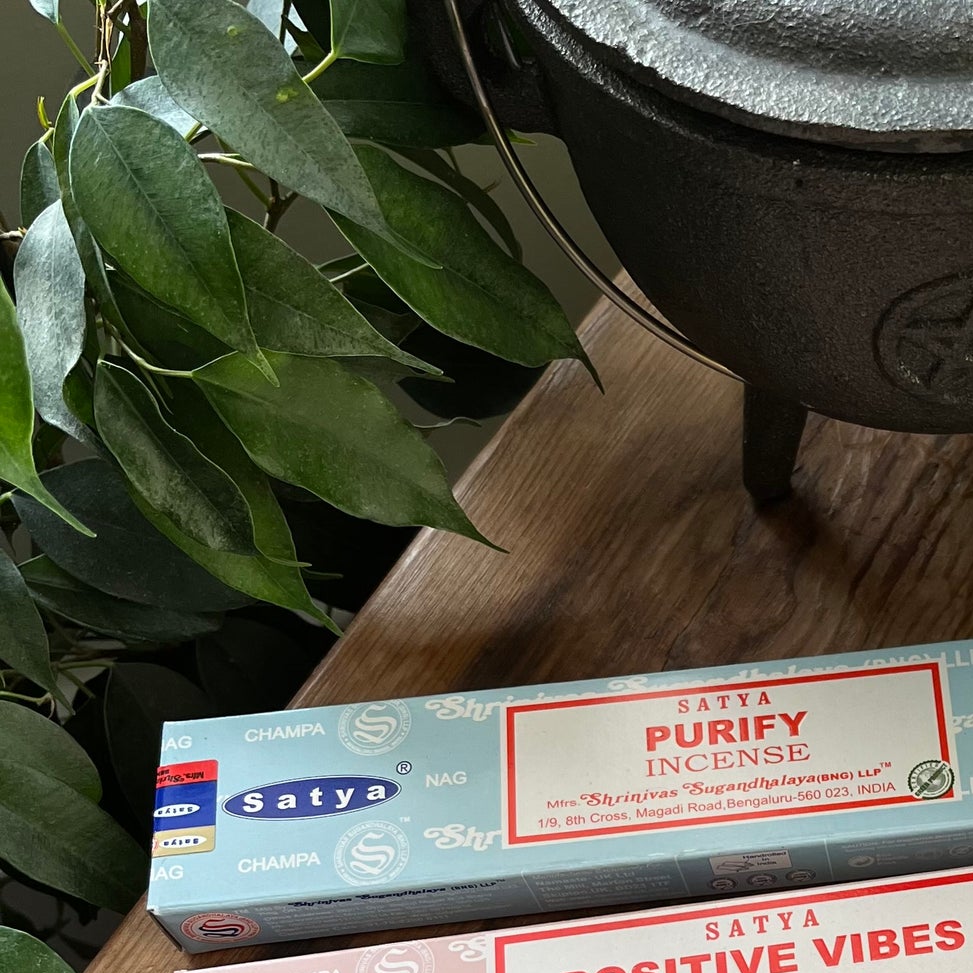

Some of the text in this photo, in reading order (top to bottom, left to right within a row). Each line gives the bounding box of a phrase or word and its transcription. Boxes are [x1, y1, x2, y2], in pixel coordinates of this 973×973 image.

[678, 691, 771, 714] SATYA
[244, 722, 326, 743] CHAMPA
[646, 711, 808, 752] PURIFY
[646, 743, 810, 777] INCENSE
[425, 771, 467, 788] NAG
[242, 784, 386, 813] Satya
[537, 817, 561, 829] 1/9,
[565, 815, 586, 825] 8th
[590, 811, 632, 823] Cross,
[636, 805, 684, 819] Magadi
[825, 786, 854, 798] 023,
[857, 781, 896, 795] INDIA
[547, 799, 580, 809] Mfrs.
[579, 786, 678, 807] Shrinivas
[237, 852, 321, 874] CHAMPA
[706, 908, 820, 941] SATYA
[812, 920, 966, 967] VIBES
